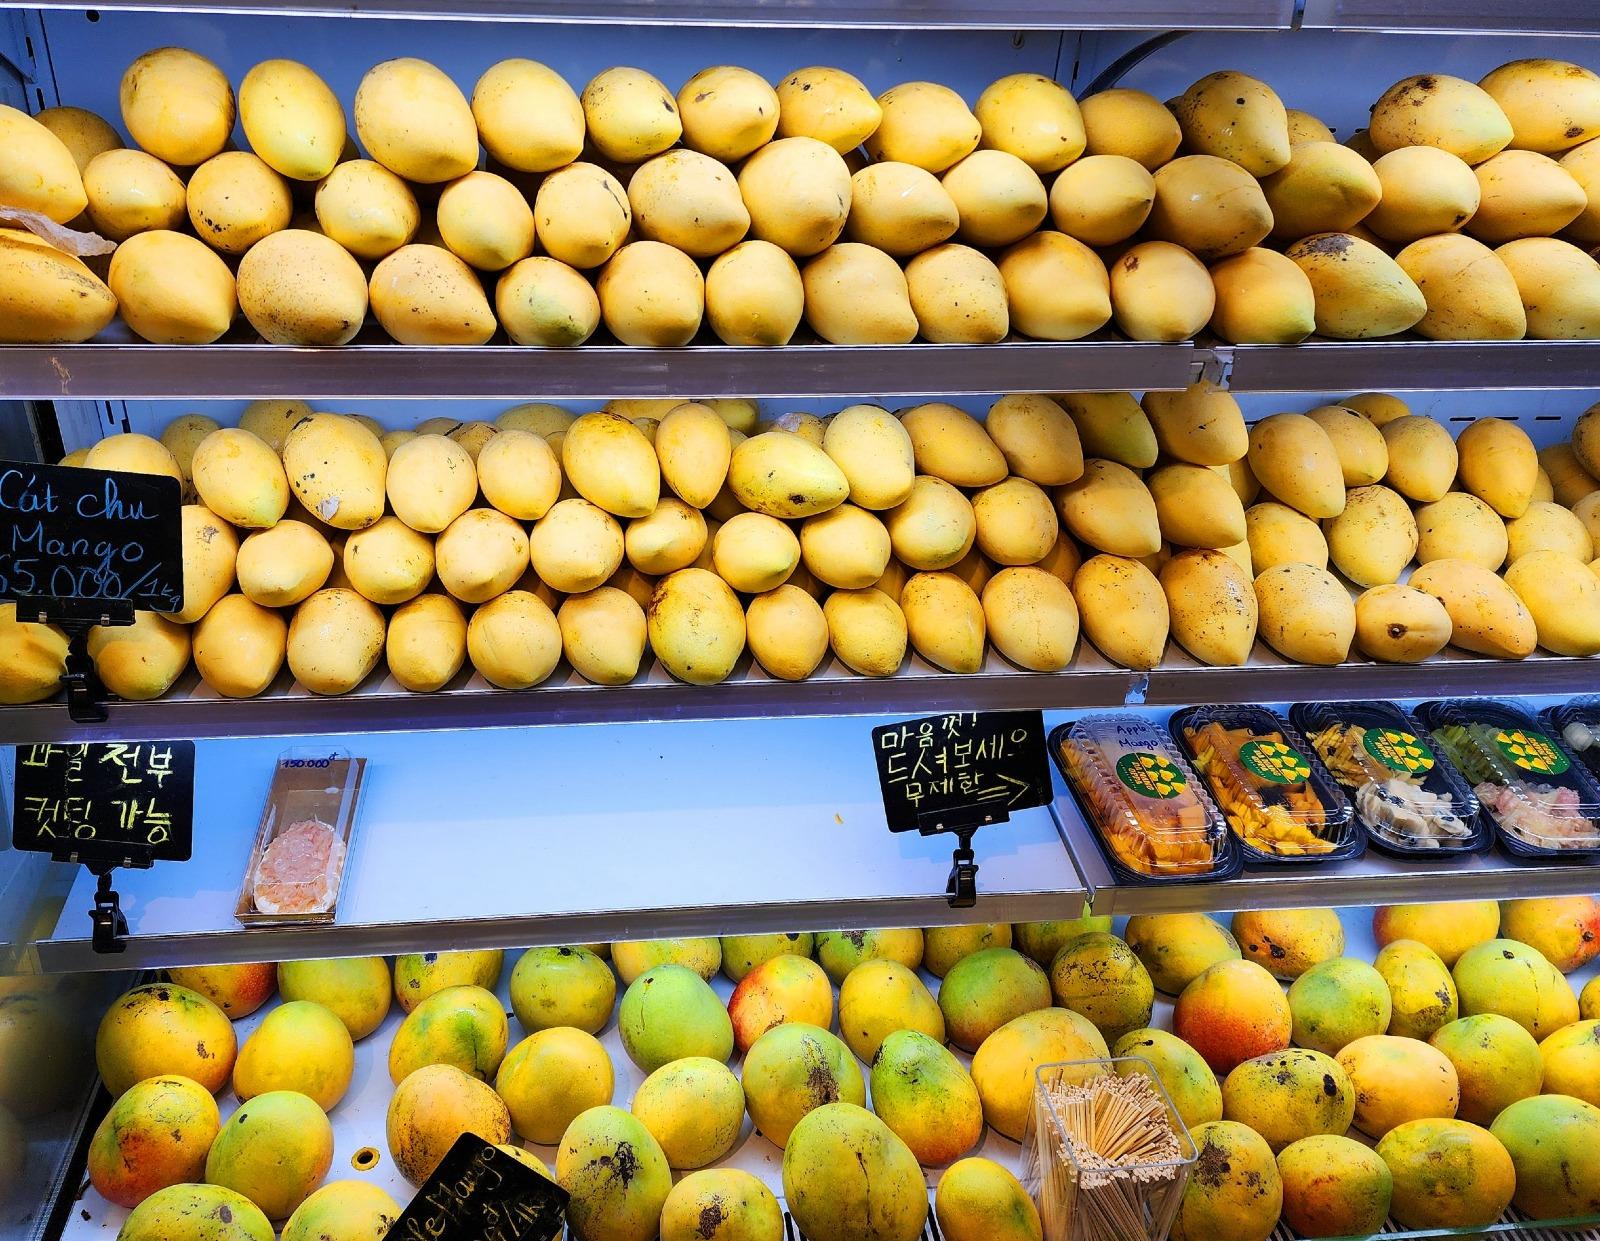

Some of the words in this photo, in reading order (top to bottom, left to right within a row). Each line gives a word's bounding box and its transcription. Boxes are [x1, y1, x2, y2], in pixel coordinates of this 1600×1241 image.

[12, 520, 144, 580] Mango
[1116, 724, 1147, 738] Apple
[1118, 739, 1159, 750] Mango
[98, 743, 174, 790] 전부
[110, 798, 172, 844] 가능
